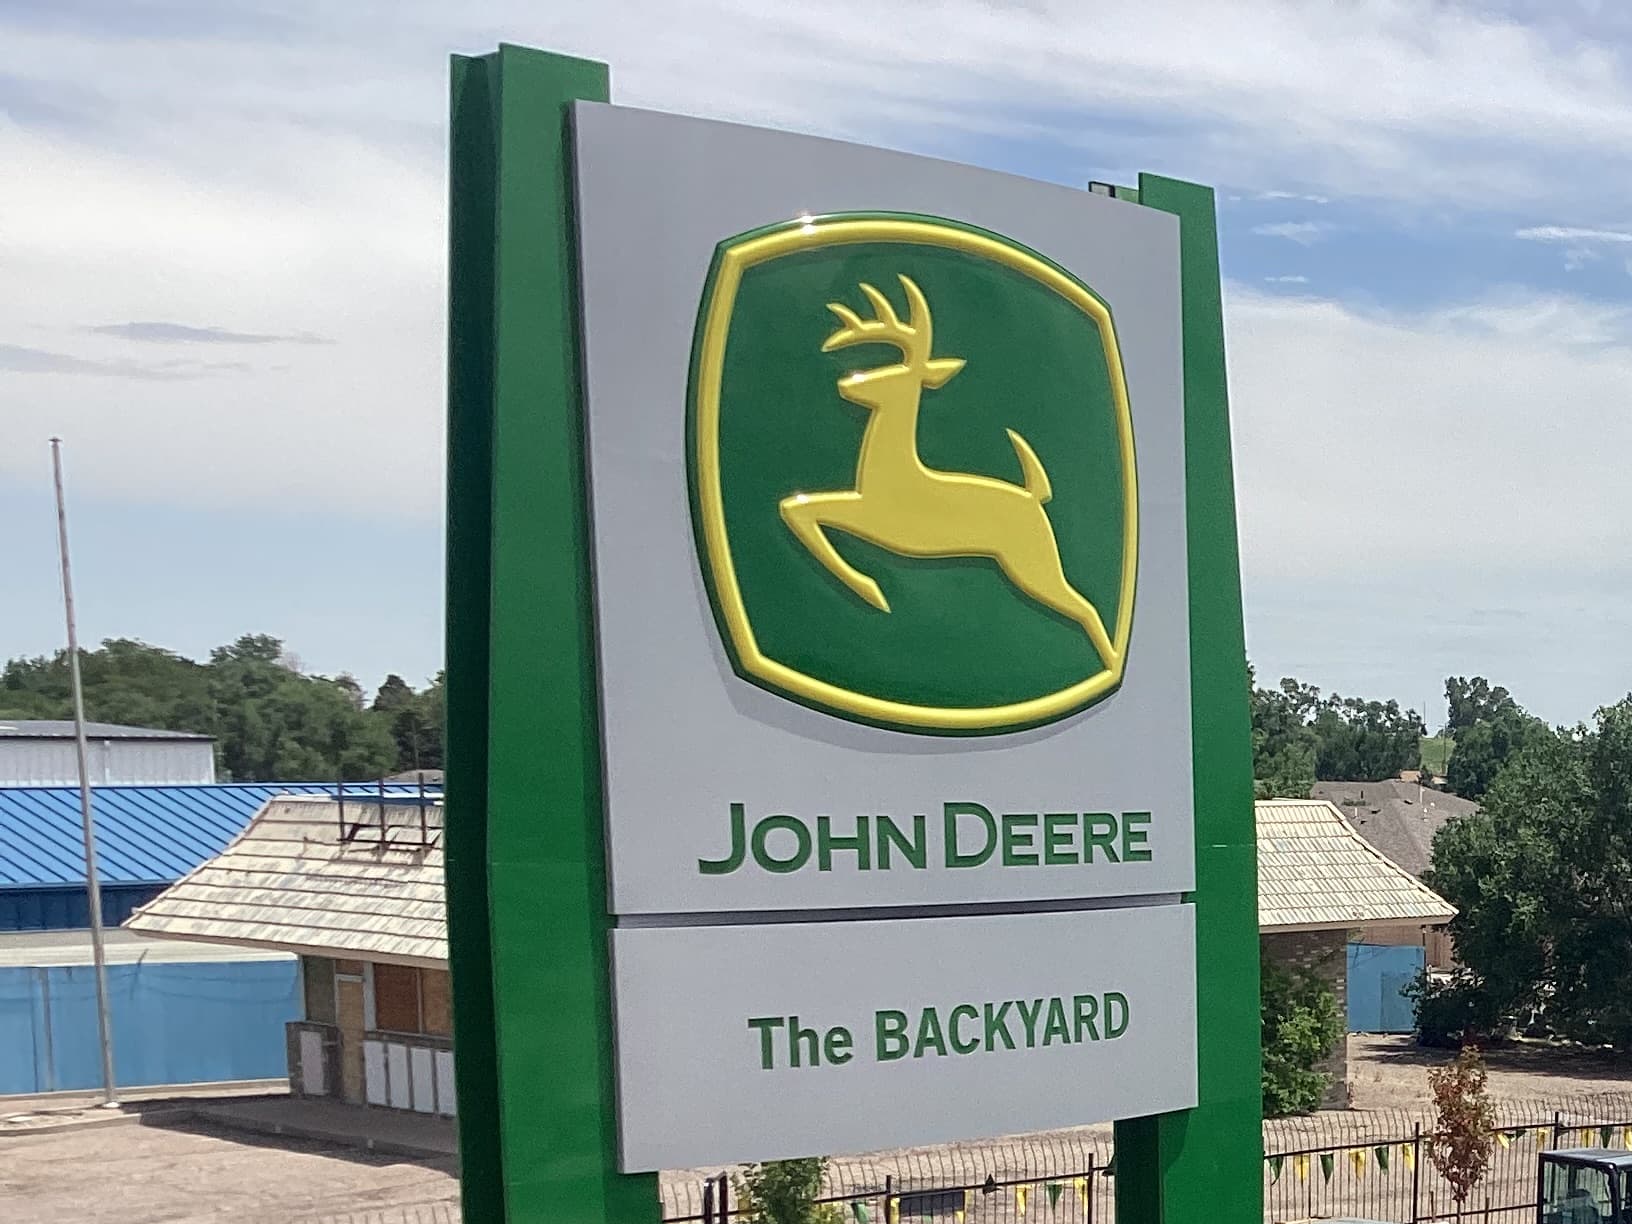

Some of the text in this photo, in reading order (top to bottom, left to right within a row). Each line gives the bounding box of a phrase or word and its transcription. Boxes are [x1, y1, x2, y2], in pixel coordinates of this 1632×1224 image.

[698, 801, 1153, 875] JOHN DEERE
[748, 991, 1130, 1070] The BACKYARD
